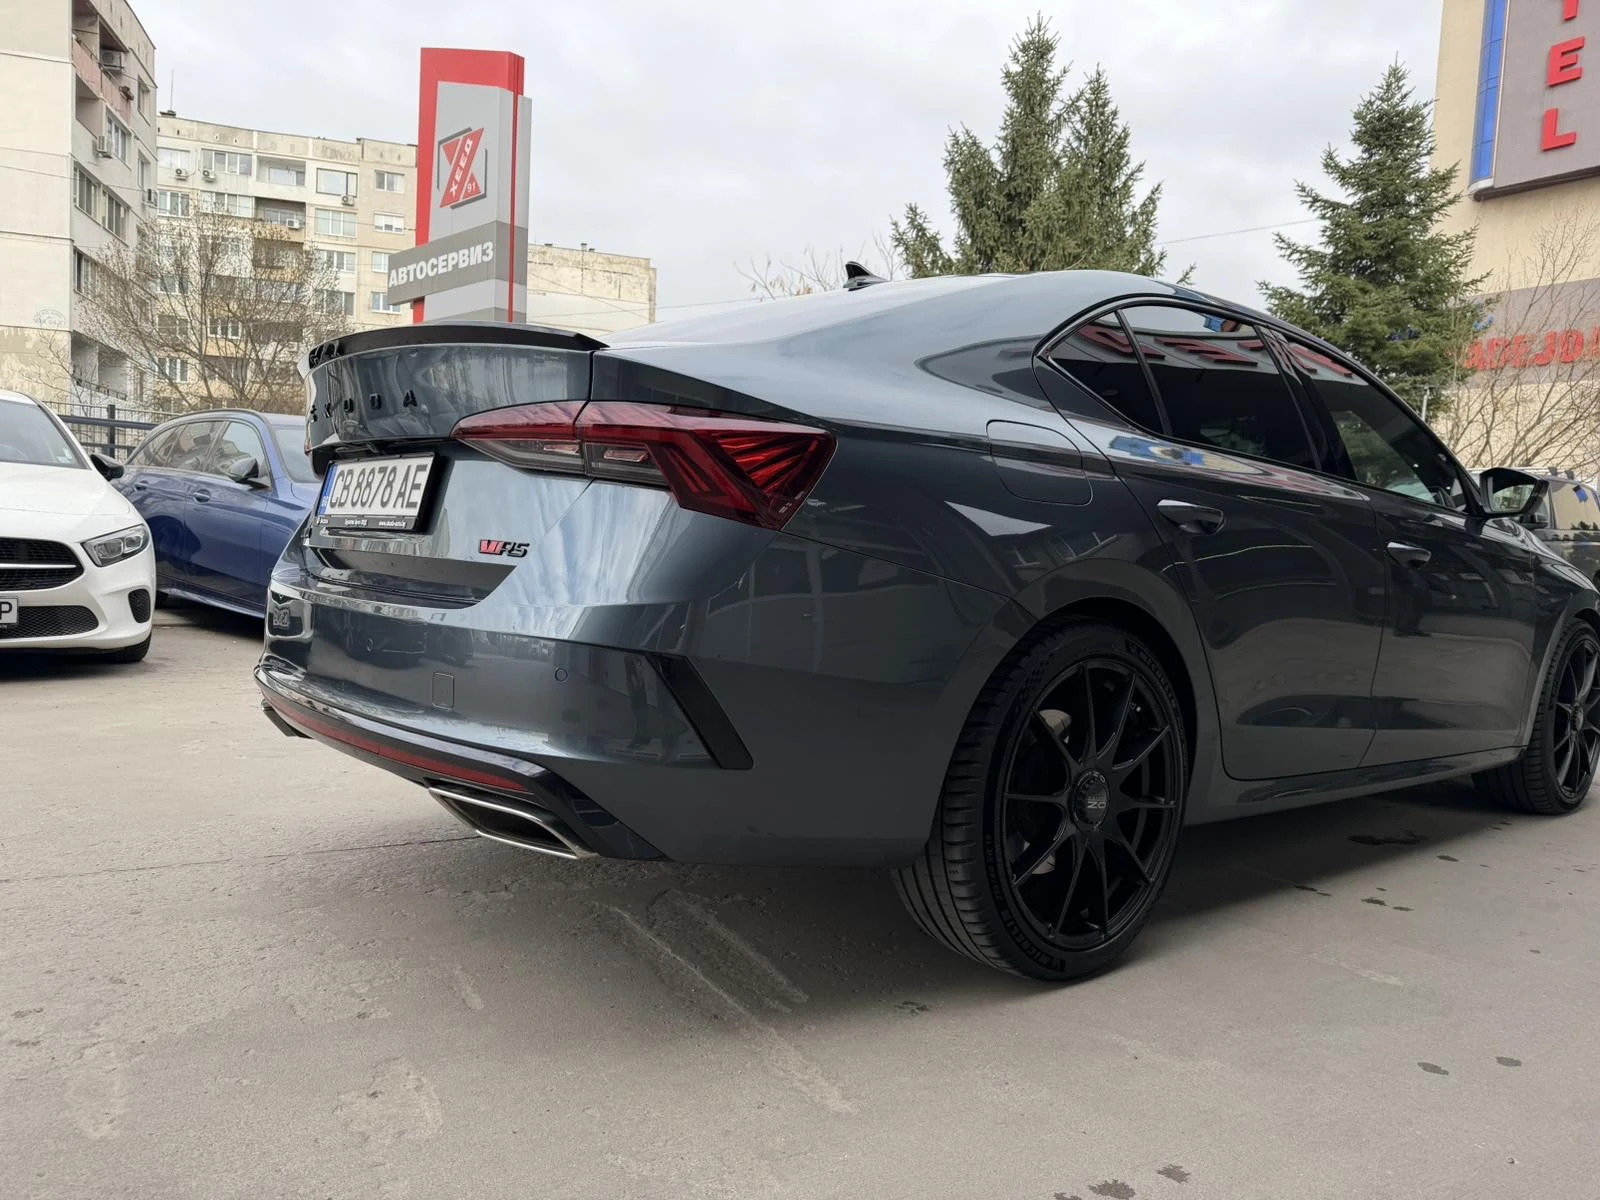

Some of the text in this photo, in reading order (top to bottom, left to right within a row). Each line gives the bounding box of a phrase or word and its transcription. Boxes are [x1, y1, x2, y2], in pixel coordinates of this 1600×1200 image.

[466, 181, 476, 193] 91
[388, 241, 494, 288] АВТОСЕРВИЗ
[329, 464, 428, 508] CB 8878 AE
